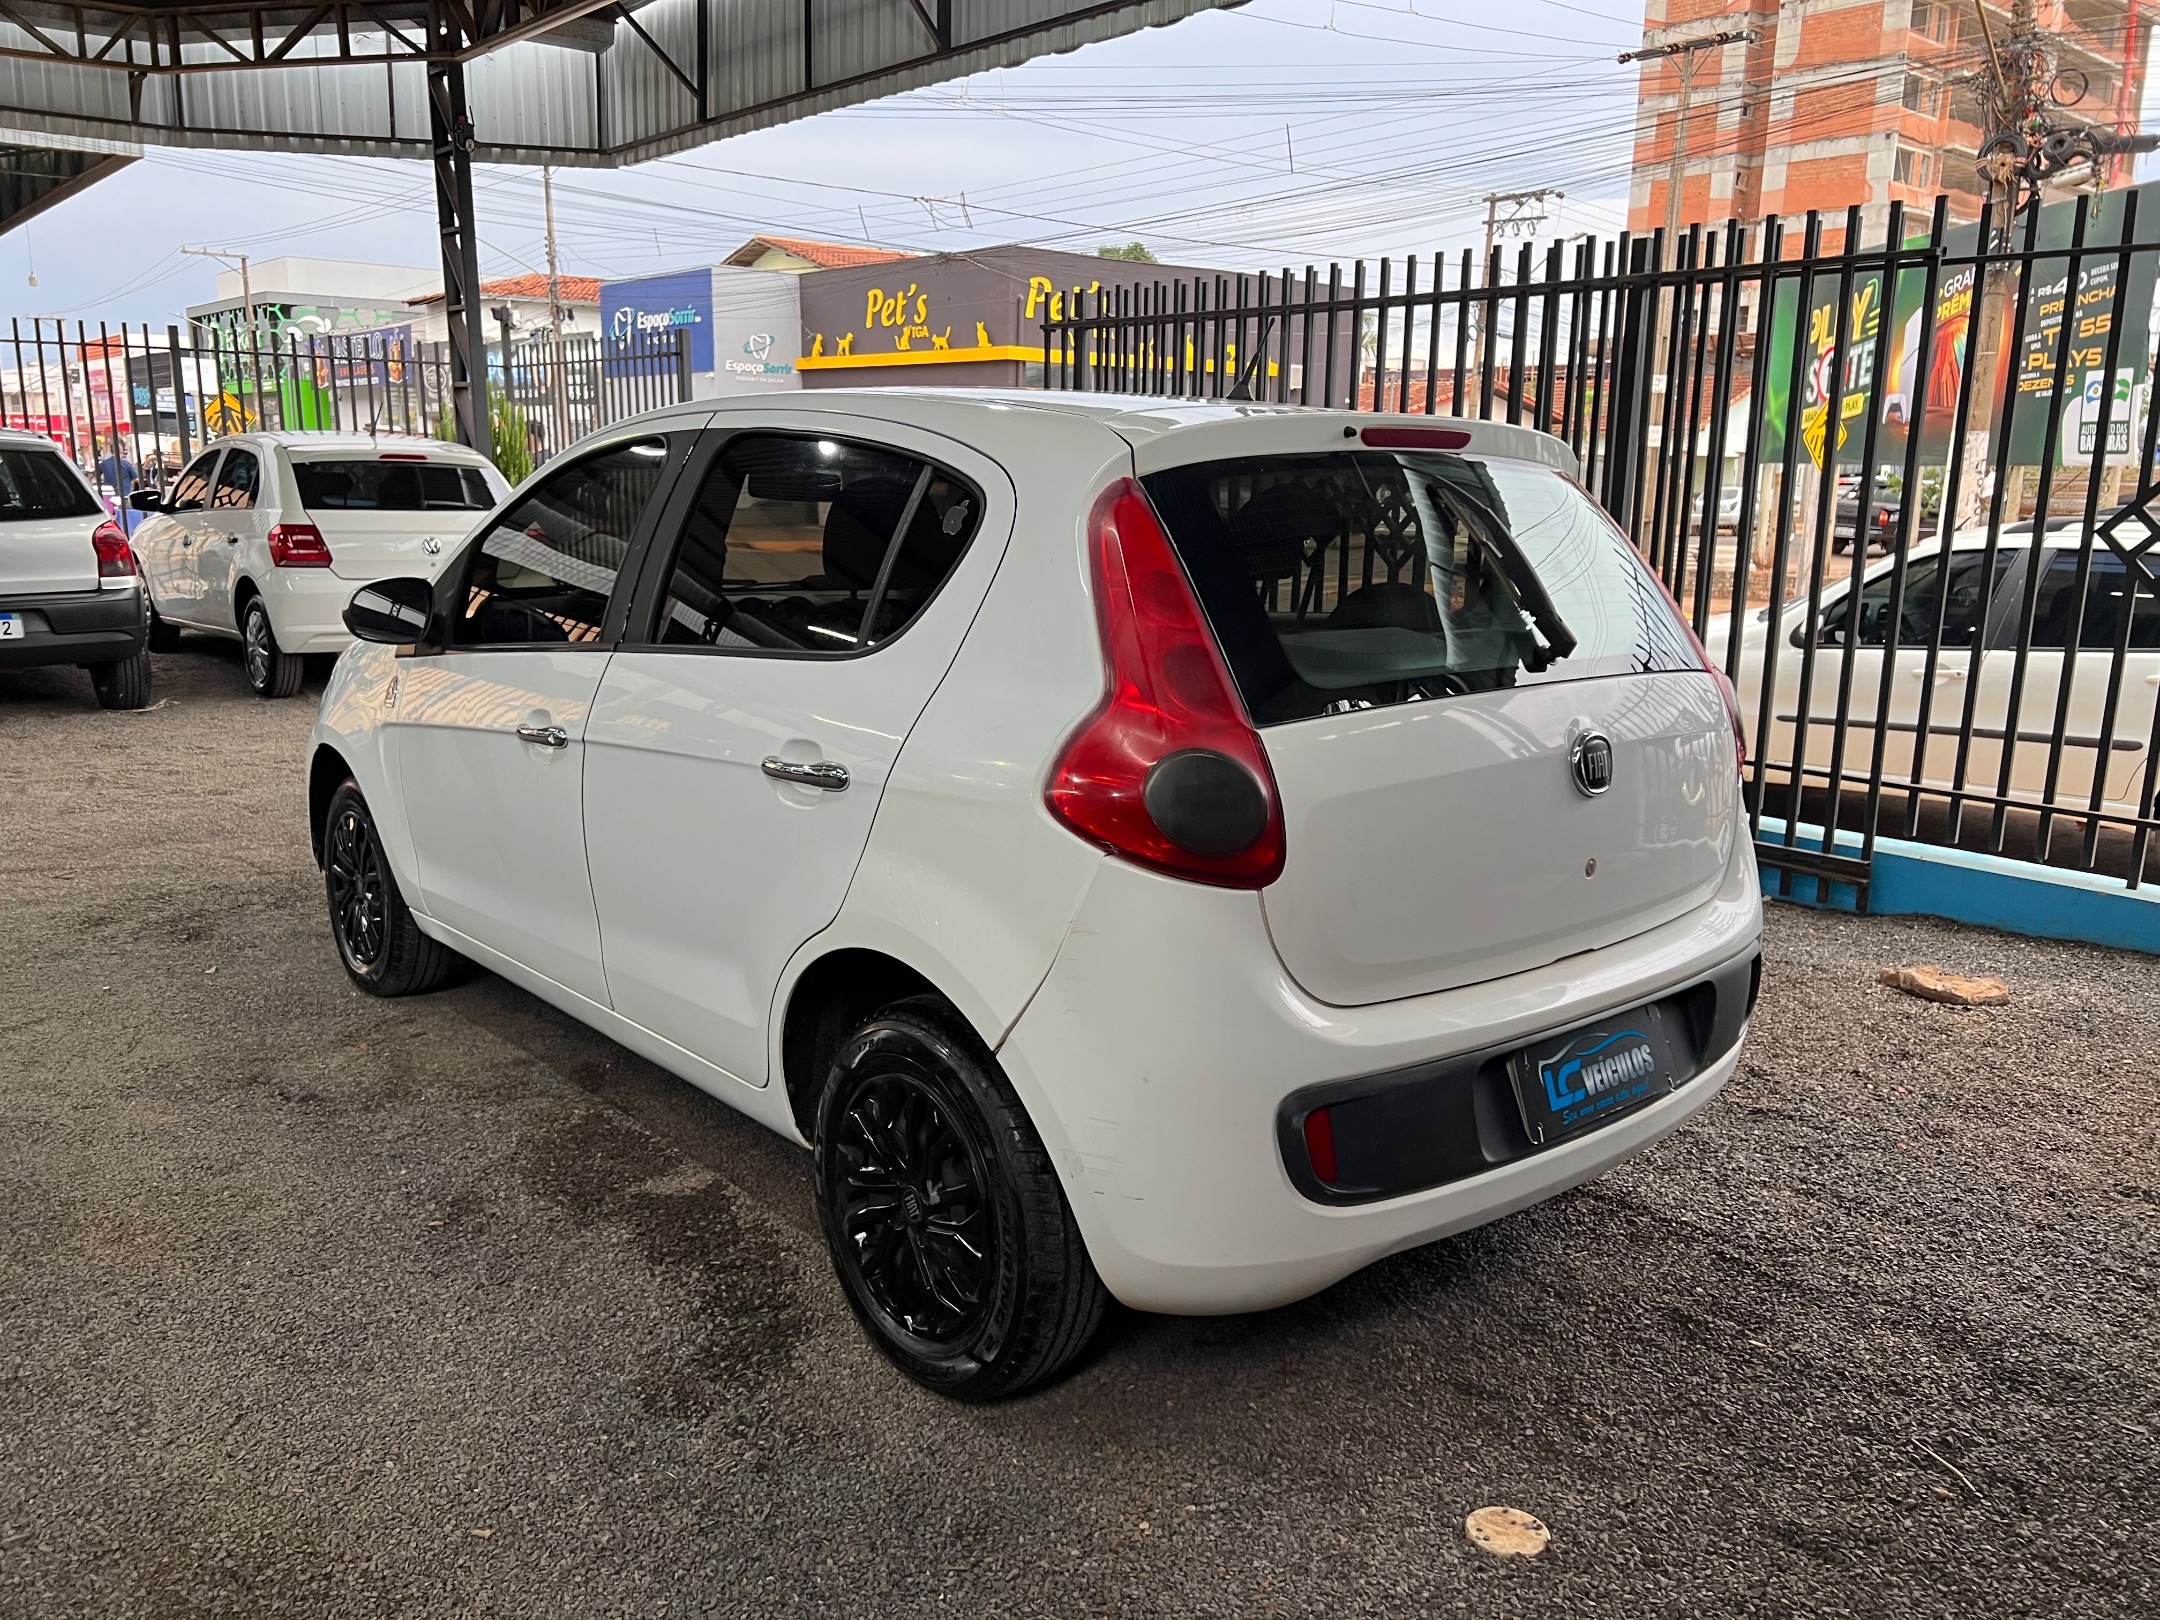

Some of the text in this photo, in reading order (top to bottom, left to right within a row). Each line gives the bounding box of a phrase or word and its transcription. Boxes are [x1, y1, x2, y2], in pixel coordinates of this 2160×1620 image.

[865, 282, 929, 330] Pet's
[2039, 284, 2118, 318] PRENCHA
[911, 325, 929, 339] TGA
[1810, 286, 1874, 356] PLY
[2079, 313, 2112, 339] 55
[1805, 339, 1877, 403] STE
[2028, 347, 2103, 371] PLY5
[2018, 373, 2075, 392] DEZENS
[1588, 750, 1608, 780] FIAT
[1544, 1058, 1587, 1112] LC
[903, 1194, 920, 1219] FIAT
